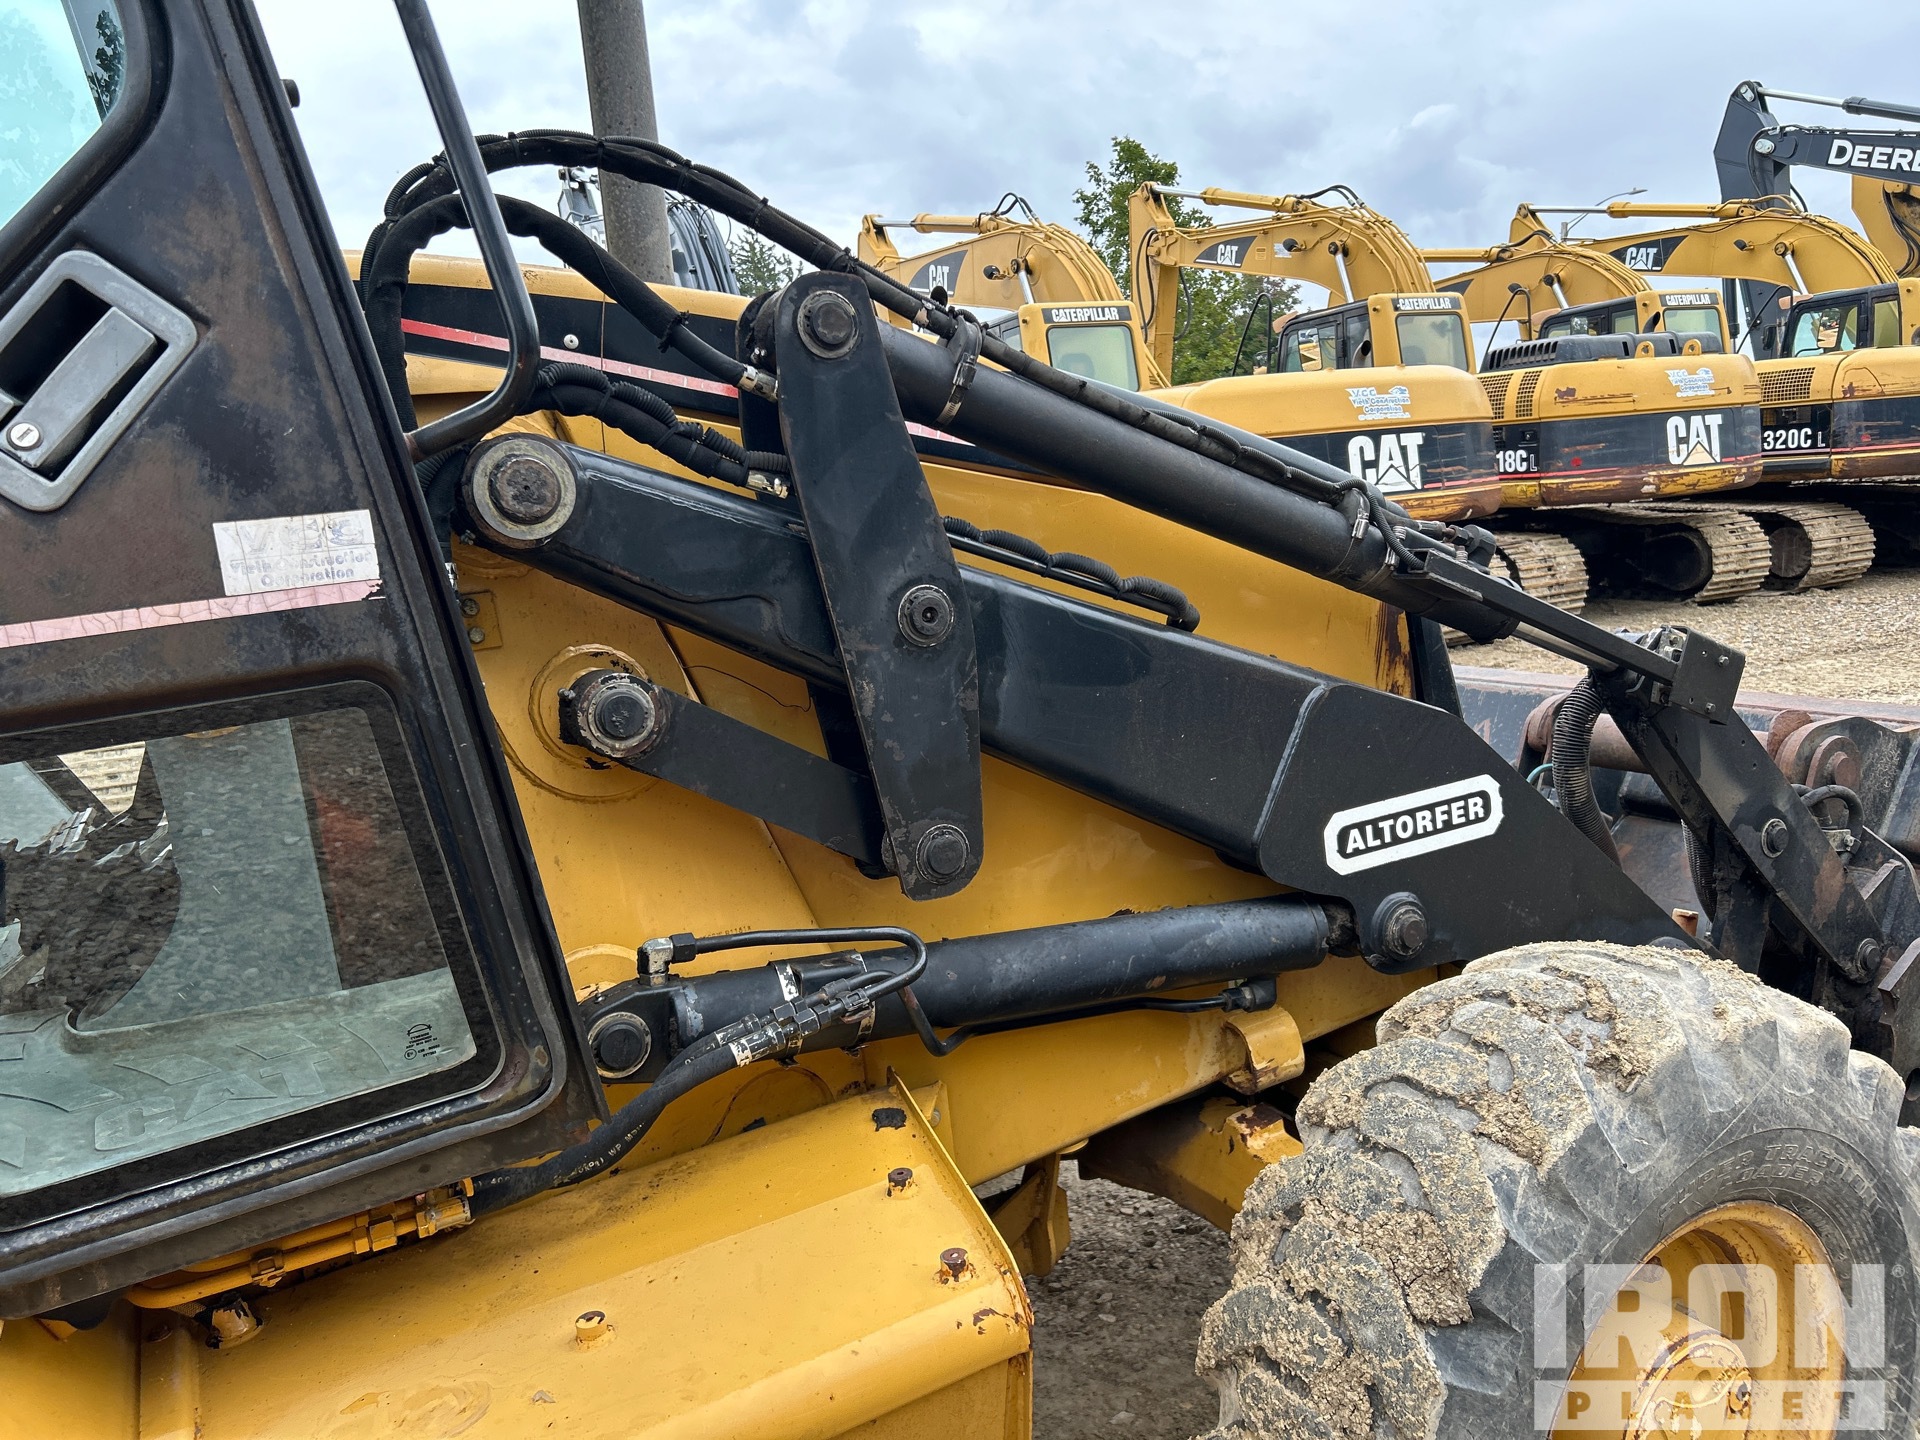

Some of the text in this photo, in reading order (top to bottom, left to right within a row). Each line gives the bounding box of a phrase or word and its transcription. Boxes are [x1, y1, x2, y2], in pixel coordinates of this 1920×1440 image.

[1217, 244, 1239, 266] CAT
[1625, 247, 1658, 270] CAT
[929, 265, 949, 293] CAT
[1398, 298, 1451, 310] CATERPILLAR
[1666, 294, 1711, 305] CATERPILLAR
[1052, 307, 1119, 322] CATERPILLAR
[1667, 414, 1722, 465] CAT
[1763, 428, 1826, 450] 320C L
[1348, 432, 1424, 492] CAT
[1496, 449, 1538, 472] 18C L
[1346, 796, 1485, 854] ALTORFER
